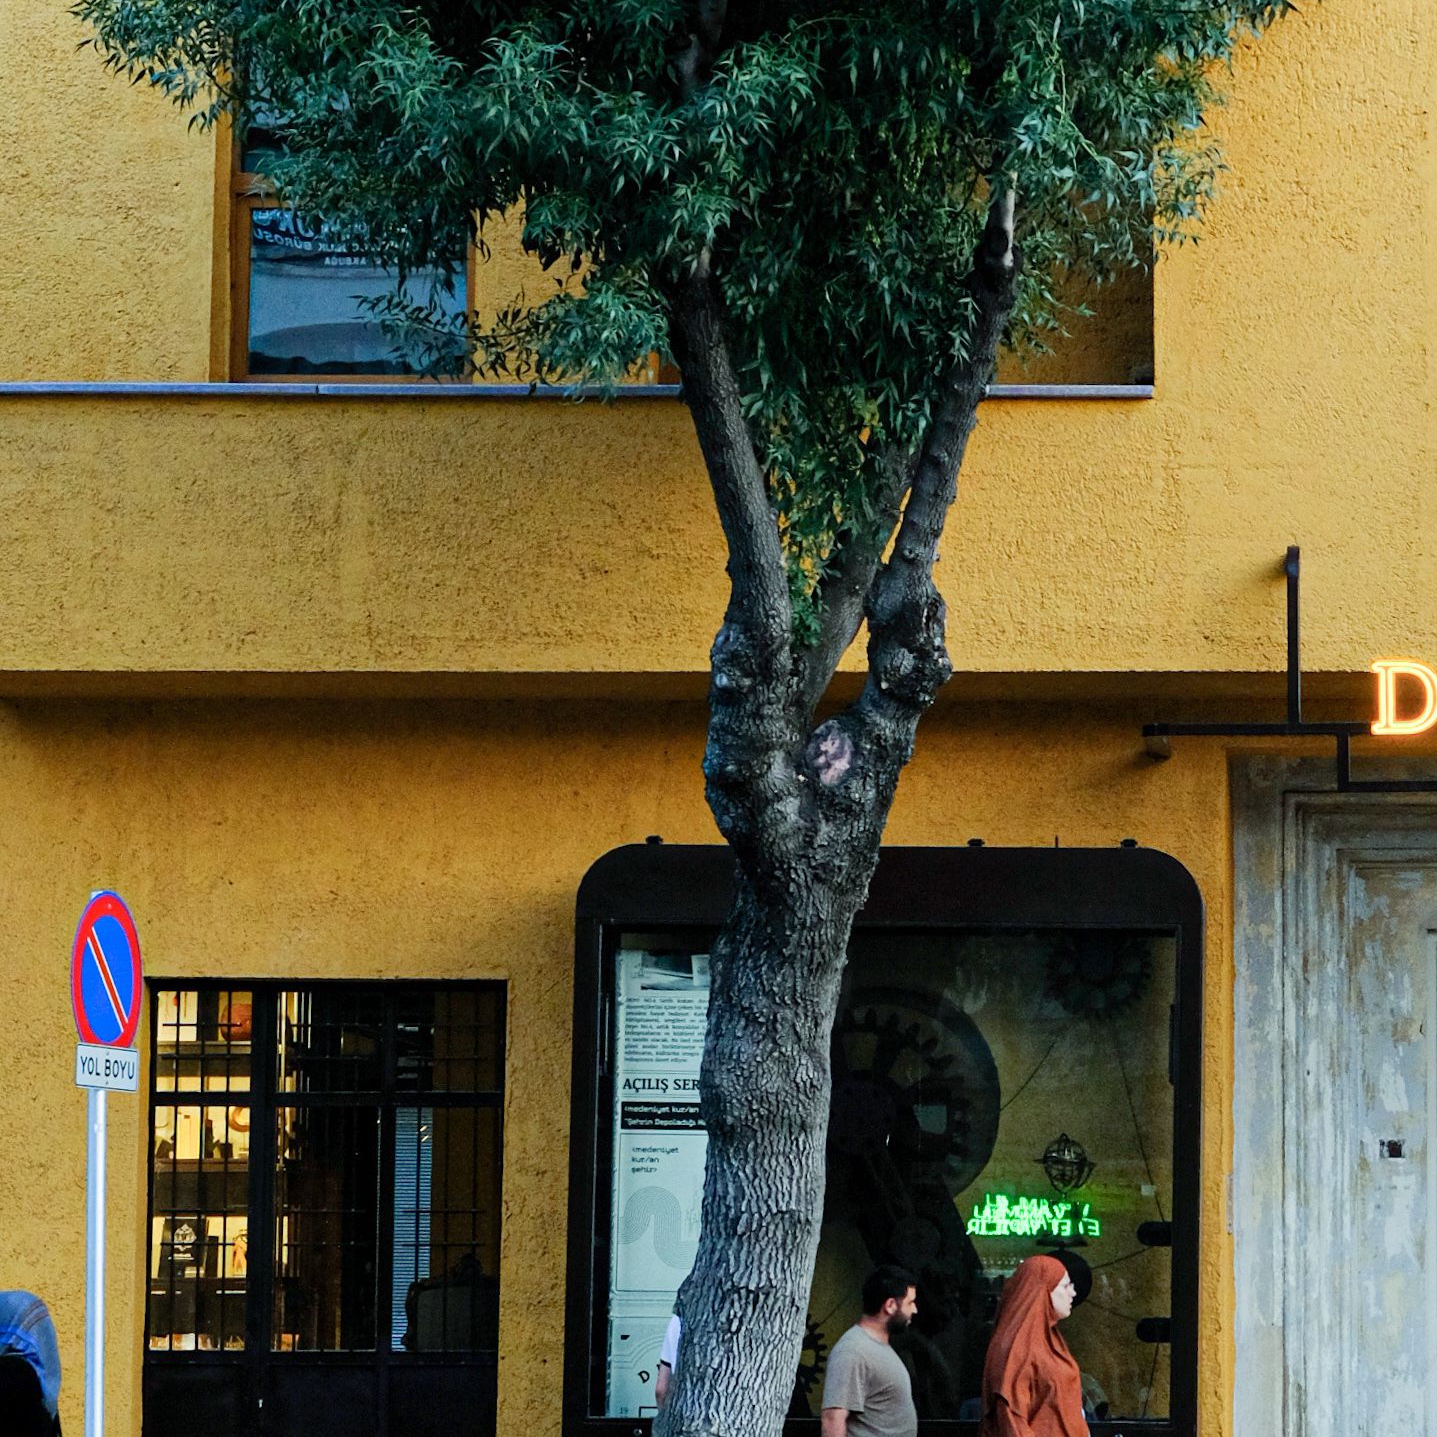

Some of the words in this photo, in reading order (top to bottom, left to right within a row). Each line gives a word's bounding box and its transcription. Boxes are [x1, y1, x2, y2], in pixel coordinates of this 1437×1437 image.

[80, 1056, 101, 1076] YOL
[104, 1059, 135, 1080] BOYU
[623, 1078, 669, 1093] AÇILIŞ
